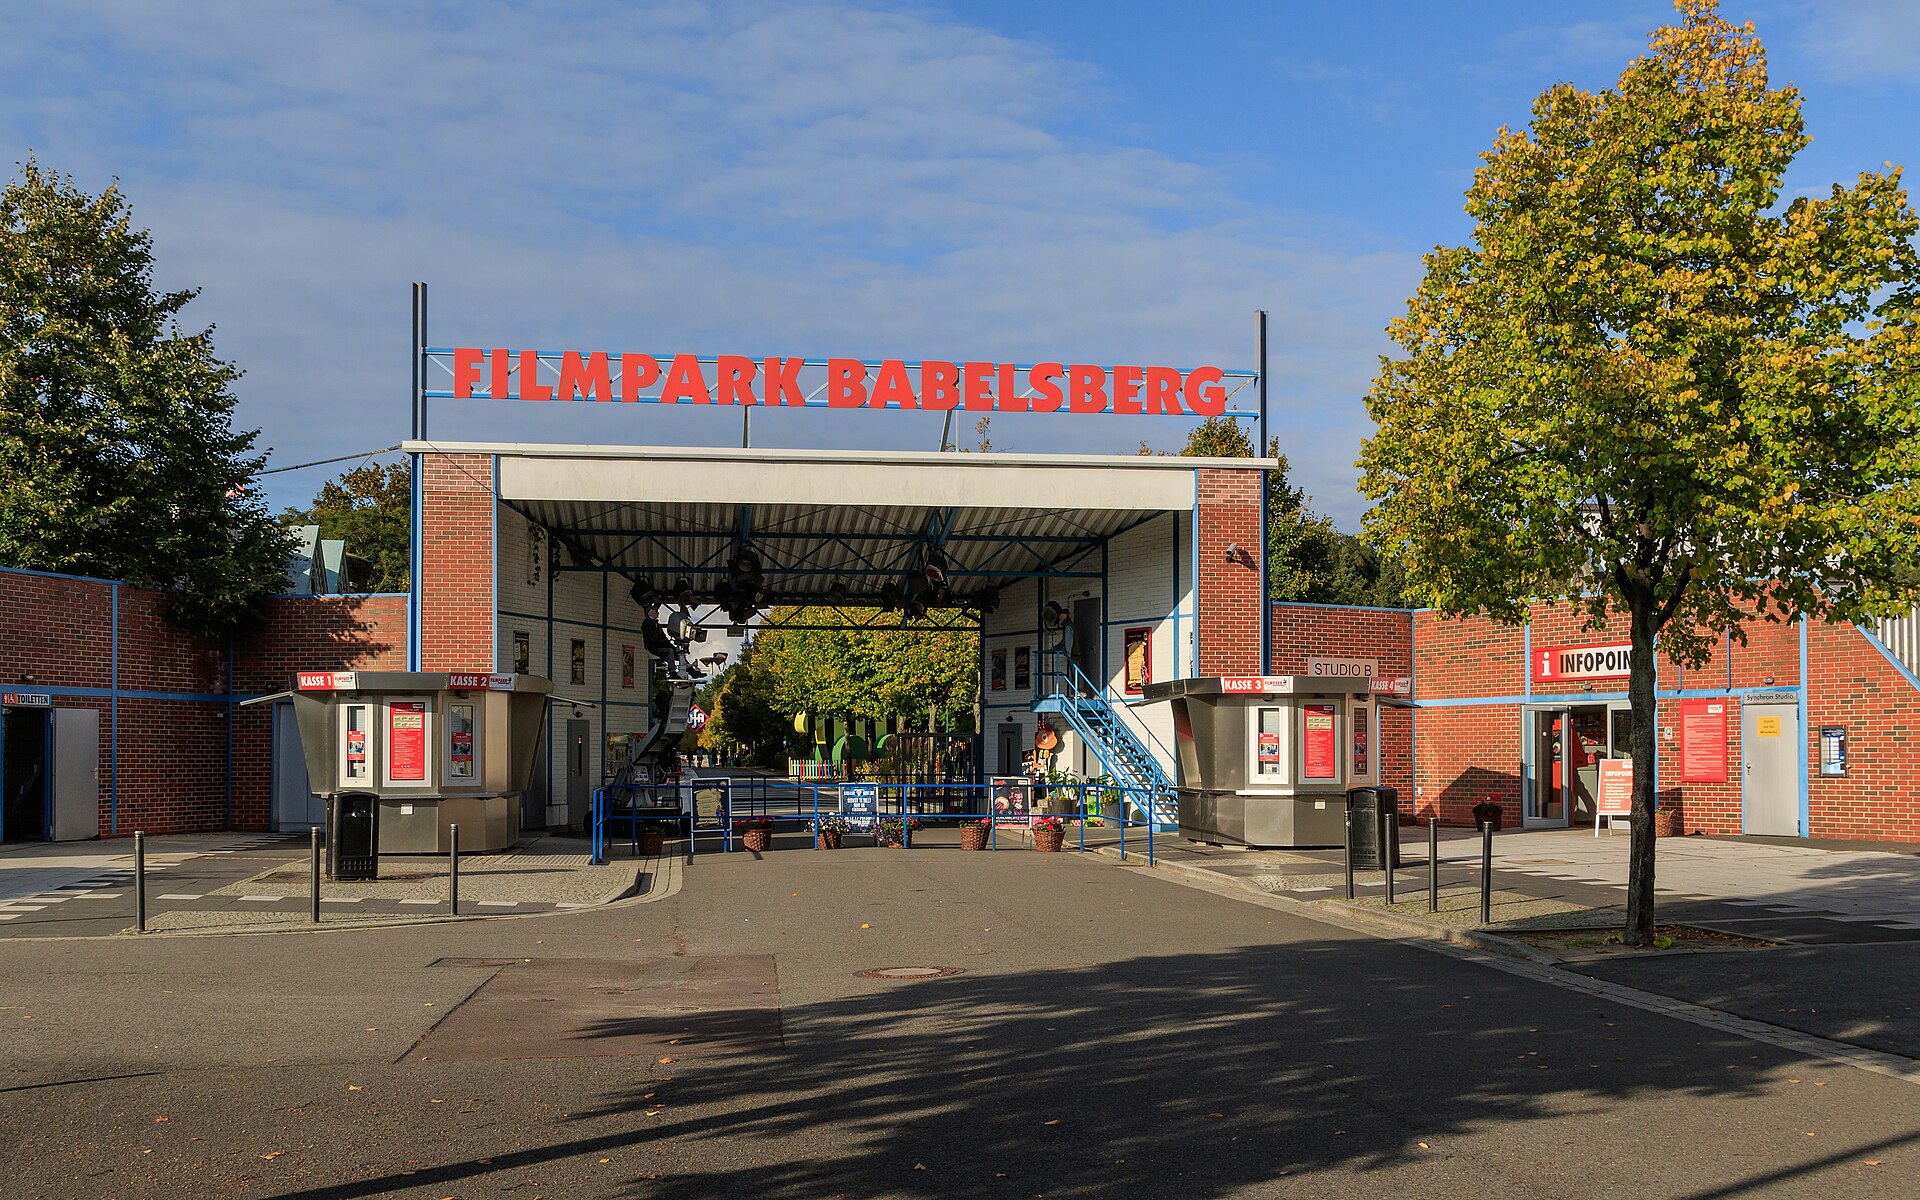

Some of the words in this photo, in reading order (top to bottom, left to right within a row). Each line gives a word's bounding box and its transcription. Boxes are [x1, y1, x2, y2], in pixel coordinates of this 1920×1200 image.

[454, 348, 806, 407] FILMPARK
[828, 358, 1226, 417] BABELSBERG
[1560, 650, 1632, 673] INFOPOIN
[1314, 663, 1361, 676] STUDIO
[1364, 665, 1372, 676] B
[301, 675, 325, 687] KASSE
[326, 676, 332, 686] 1
[450, 675, 478, 687] KASSE
[480, 677, 487, 687] 2
[1225, 680, 1253, 690] KASSE
[1255, 680, 1262, 690] 3
[1371, 680, 1389, 690] KASSE
[1389, 680, 1394, 691] 4
[17, 694, 49, 704] TOILETTEN
